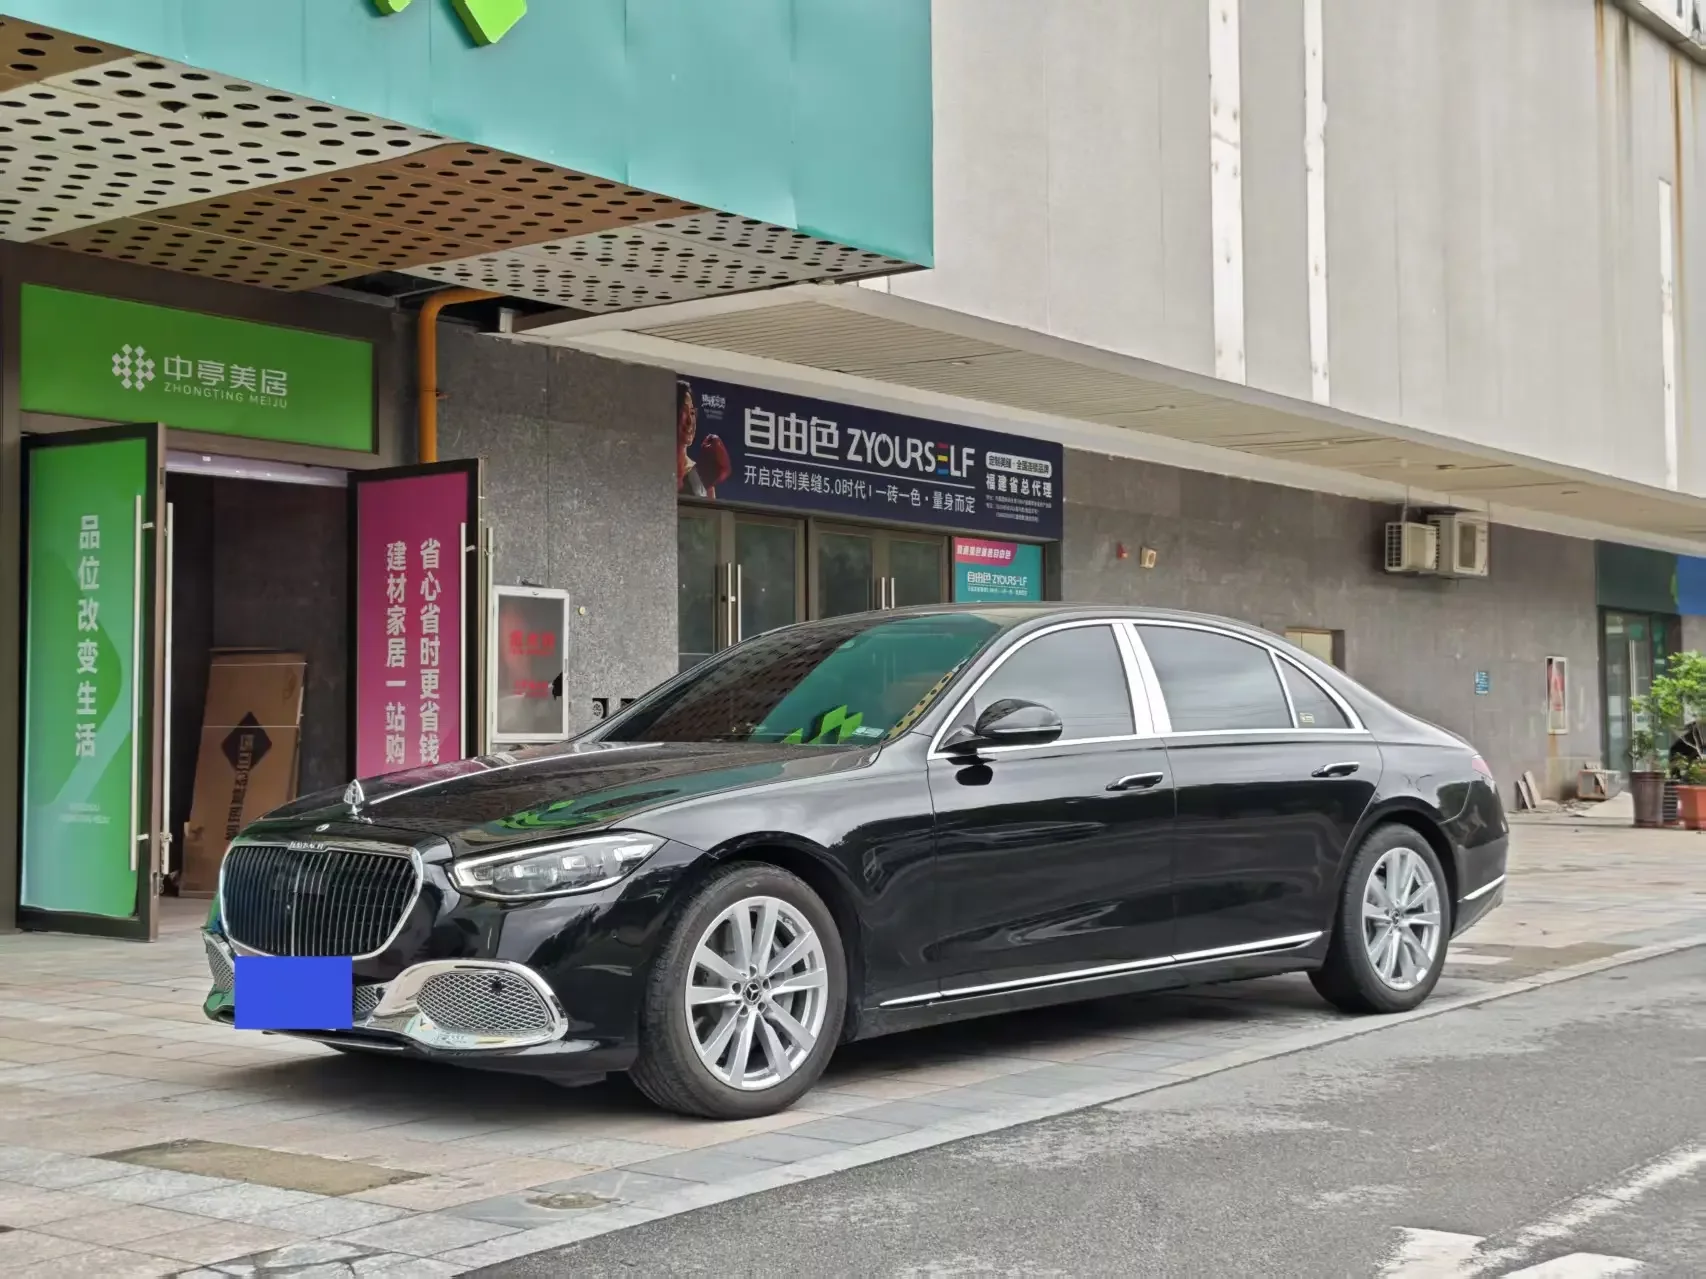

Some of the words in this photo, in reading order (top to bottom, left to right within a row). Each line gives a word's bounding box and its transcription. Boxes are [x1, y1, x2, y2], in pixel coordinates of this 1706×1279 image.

[164, 354, 288, 397] 中亭美居
[164, 382, 244, 402] ZHONGTING
[250, 395, 288, 409] MEIJU
[744, 406, 839, 460] 自由色
[985, 472, 1053, 498] 福建省总代理
[75, 514, 100, 757] 品位改变生活
[385, 541, 407, 765] 建材家居一站购
[419, 537, 441, 765] 省心省时更省钱
